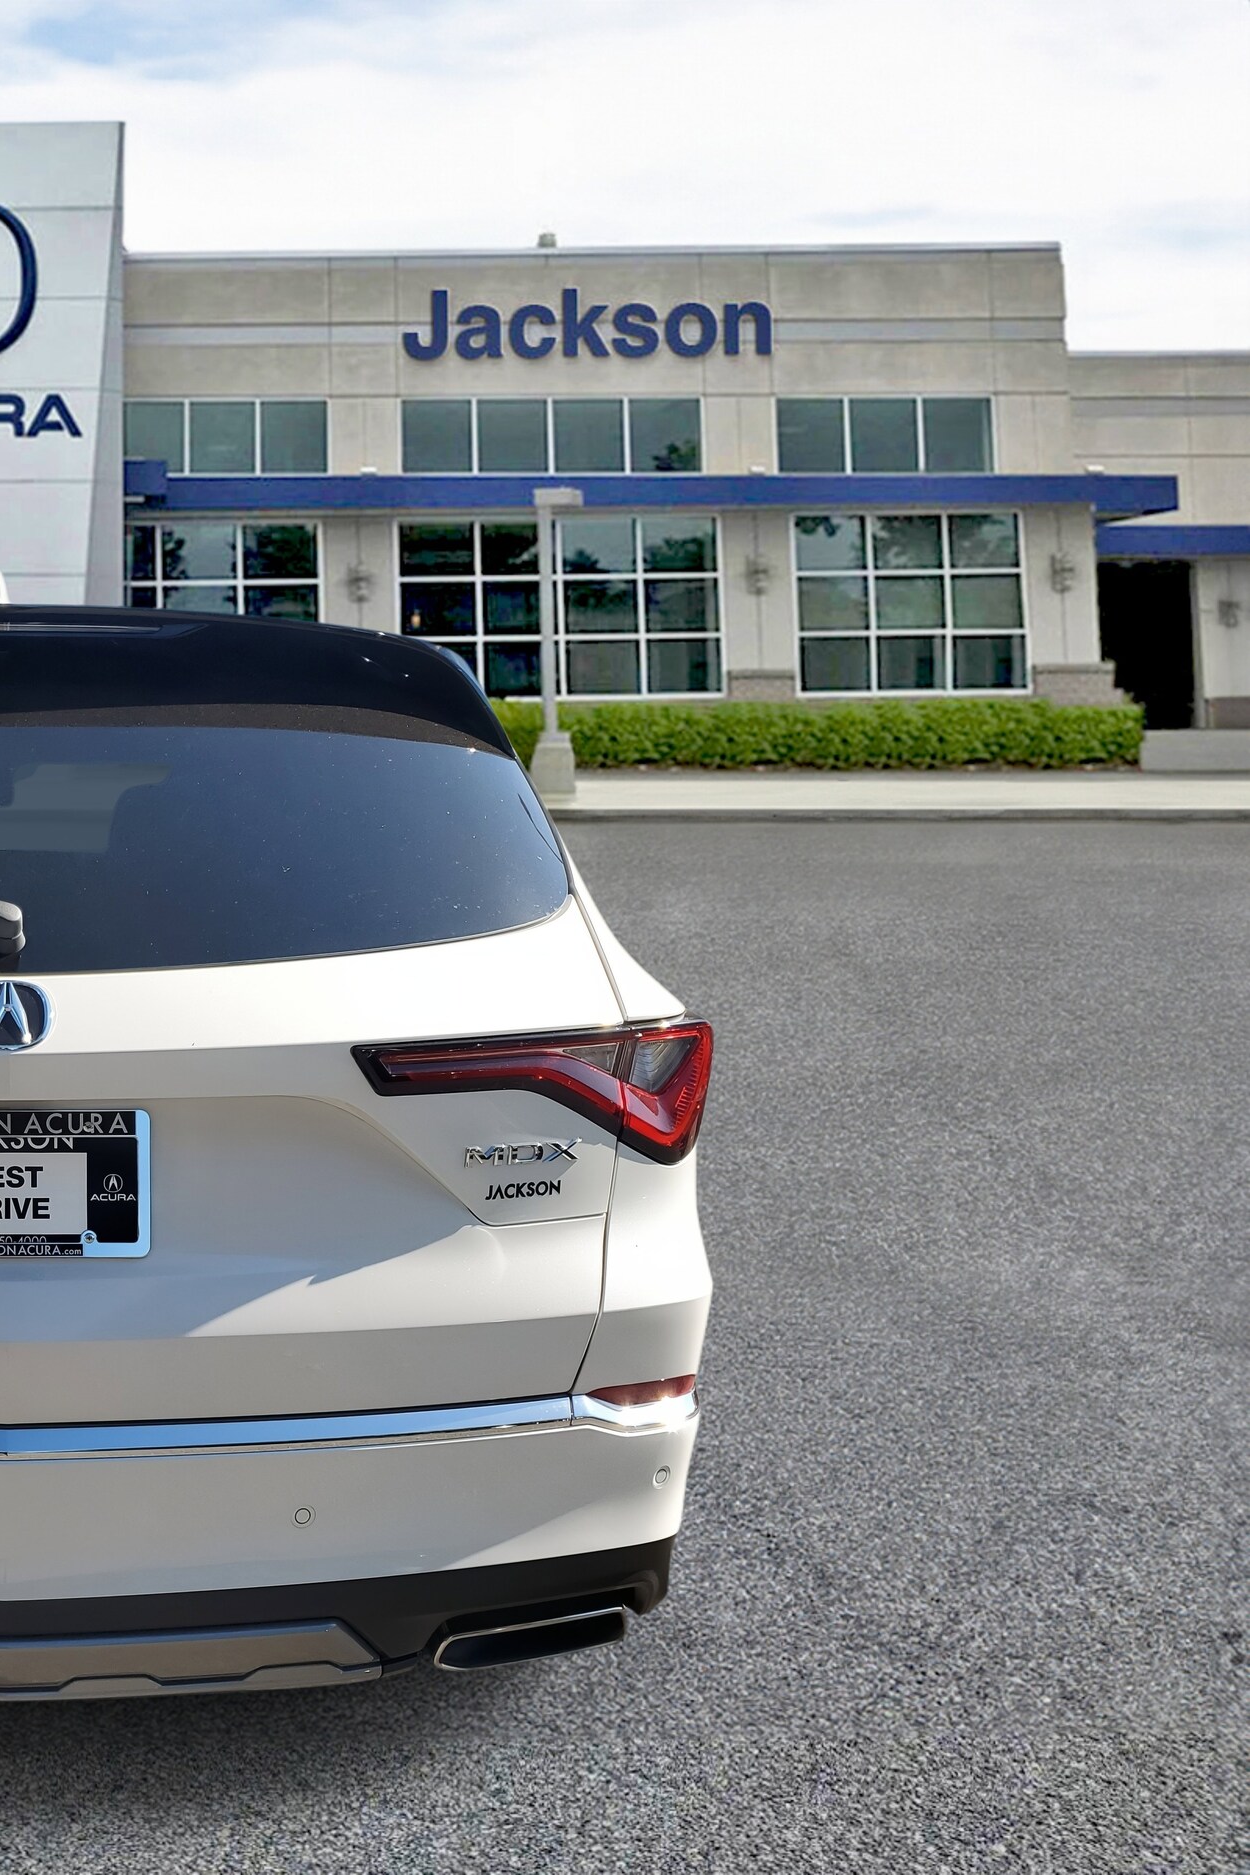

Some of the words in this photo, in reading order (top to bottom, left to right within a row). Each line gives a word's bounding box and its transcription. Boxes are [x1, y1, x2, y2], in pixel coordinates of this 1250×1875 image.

[402, 288, 773, 361] Jackson
[23, 1112, 129, 1135] ACURA
[464, 1136, 583, 1168] MDX
[90, 1193, 137, 1202] ACURA
[485, 1180, 561, 1200] JACKSON
